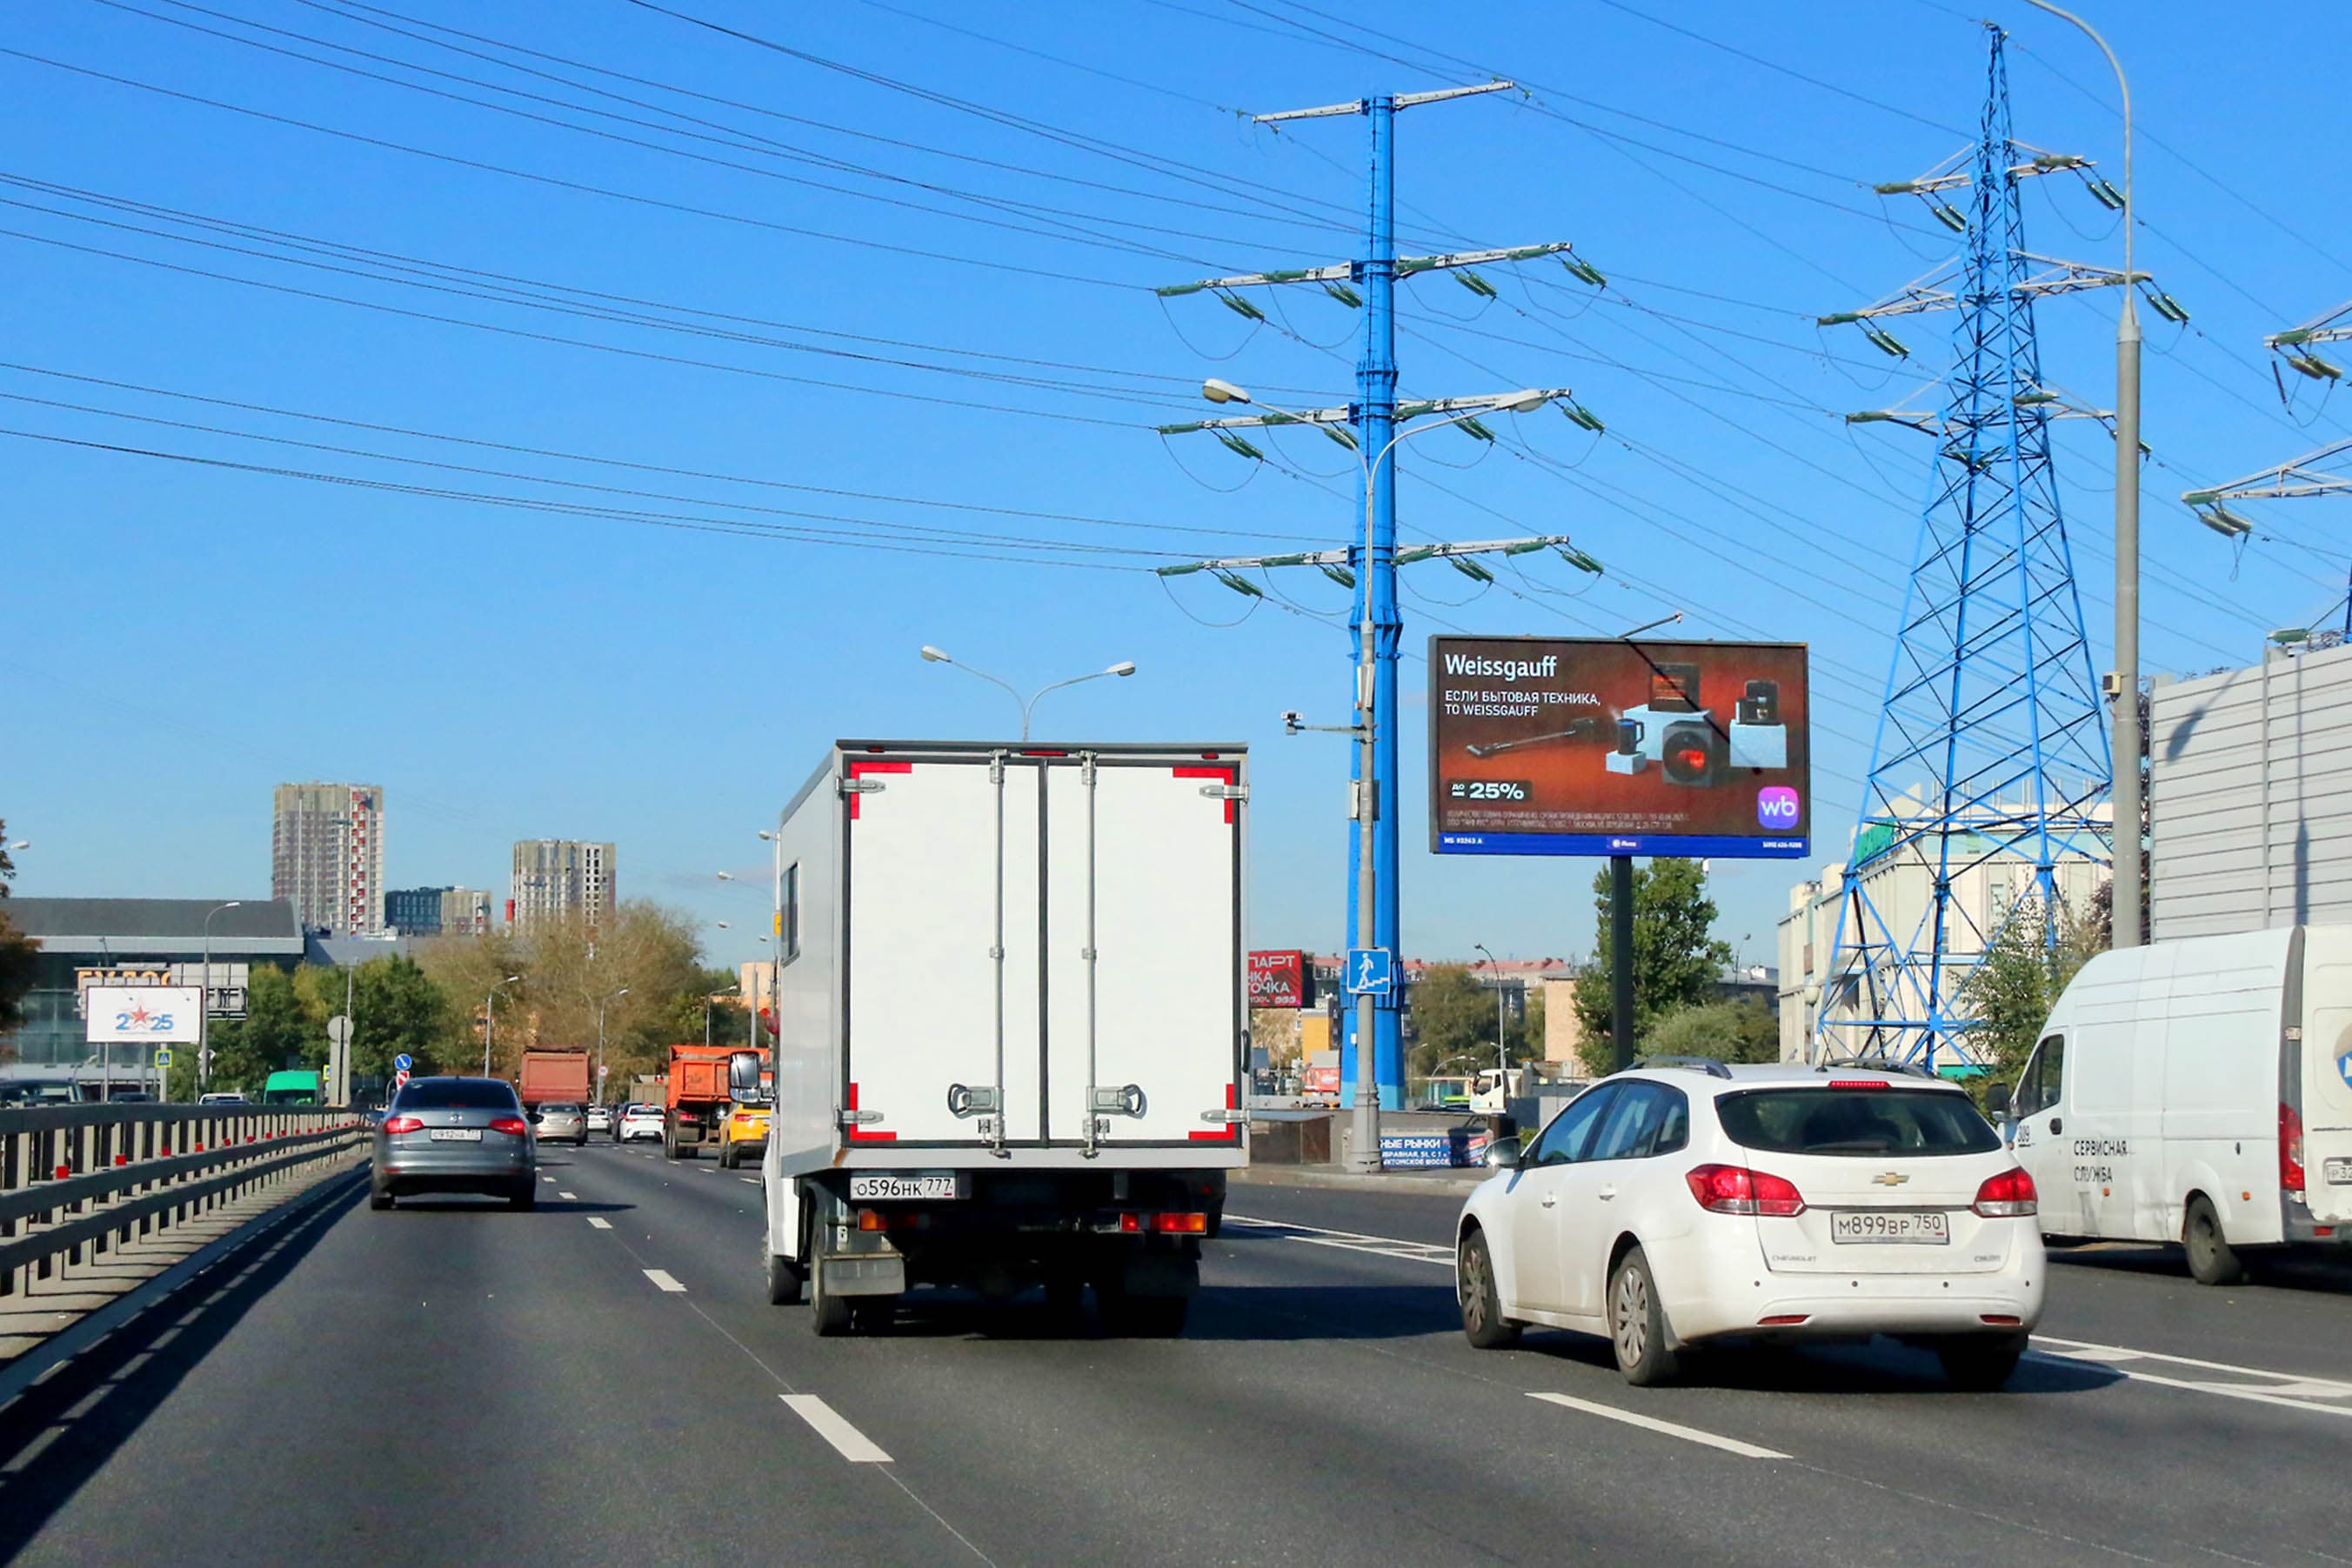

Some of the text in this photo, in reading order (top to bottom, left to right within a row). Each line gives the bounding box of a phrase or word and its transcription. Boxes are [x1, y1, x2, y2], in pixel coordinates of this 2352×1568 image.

[1445, 654, 1557, 681] Weissgauff
[1445, 691, 1601, 706] ЕСЛИ БЫТОВАЯ ТЕХНИКА,
[1445, 704, 1539, 717] ТО WEISSGAUFF
[1761, 795, 1796, 817] wb
[1404, 1138, 1441, 1149] РЫНКИ
[2074, 1140, 2128, 1156] СЕРВИСНАЯ
[2074, 1166, 2114, 1183] СЛУЖБА
[857, 1178, 952, 1196] О596НК 777
[1839, 1215, 1941, 1235] М899ВР 750
